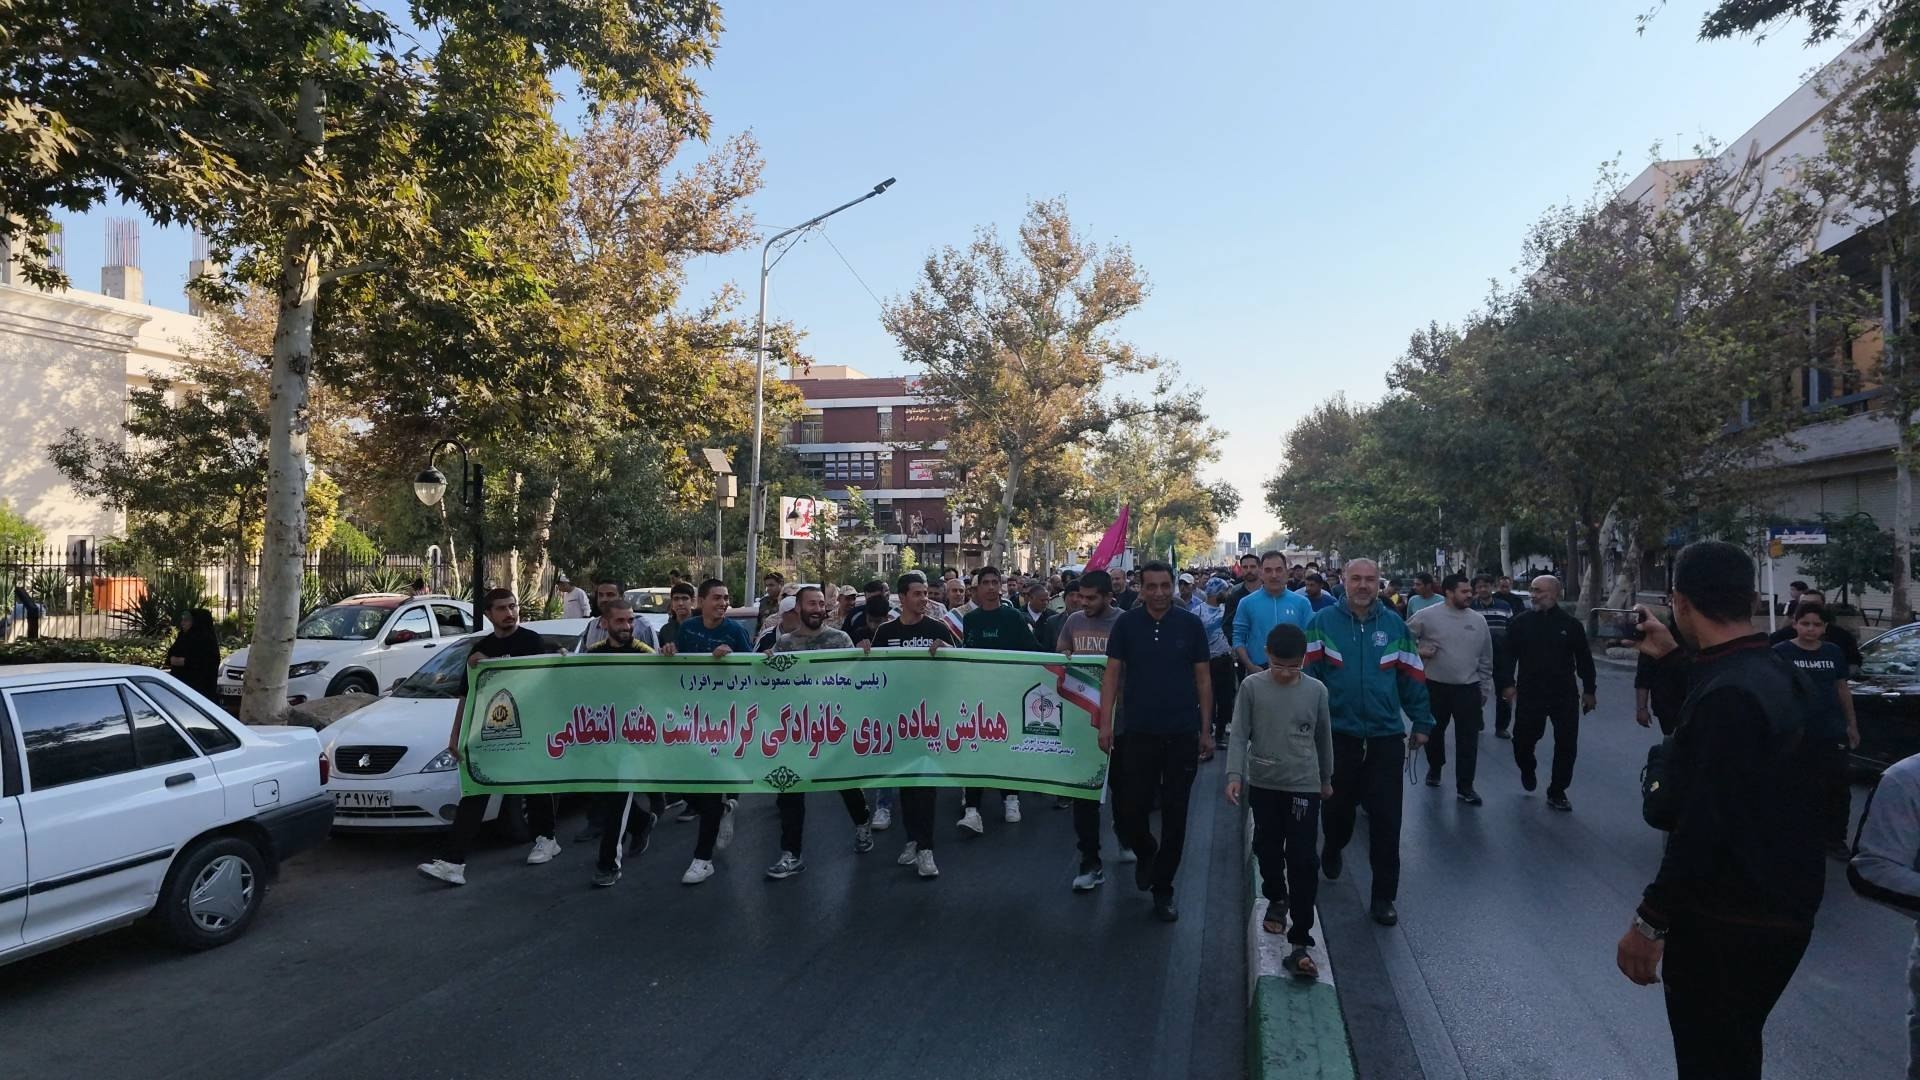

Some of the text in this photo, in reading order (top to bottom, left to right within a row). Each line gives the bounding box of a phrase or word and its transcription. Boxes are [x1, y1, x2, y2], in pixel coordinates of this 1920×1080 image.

[903, 636, 933, 647] adidas
[727, 673, 751, 690] ایران
[794, 673, 813, 687] ملت
[546, 699, 1008, 759] همایش پیاده روی خانوادگی گرامیداشت هفته انتظامی
